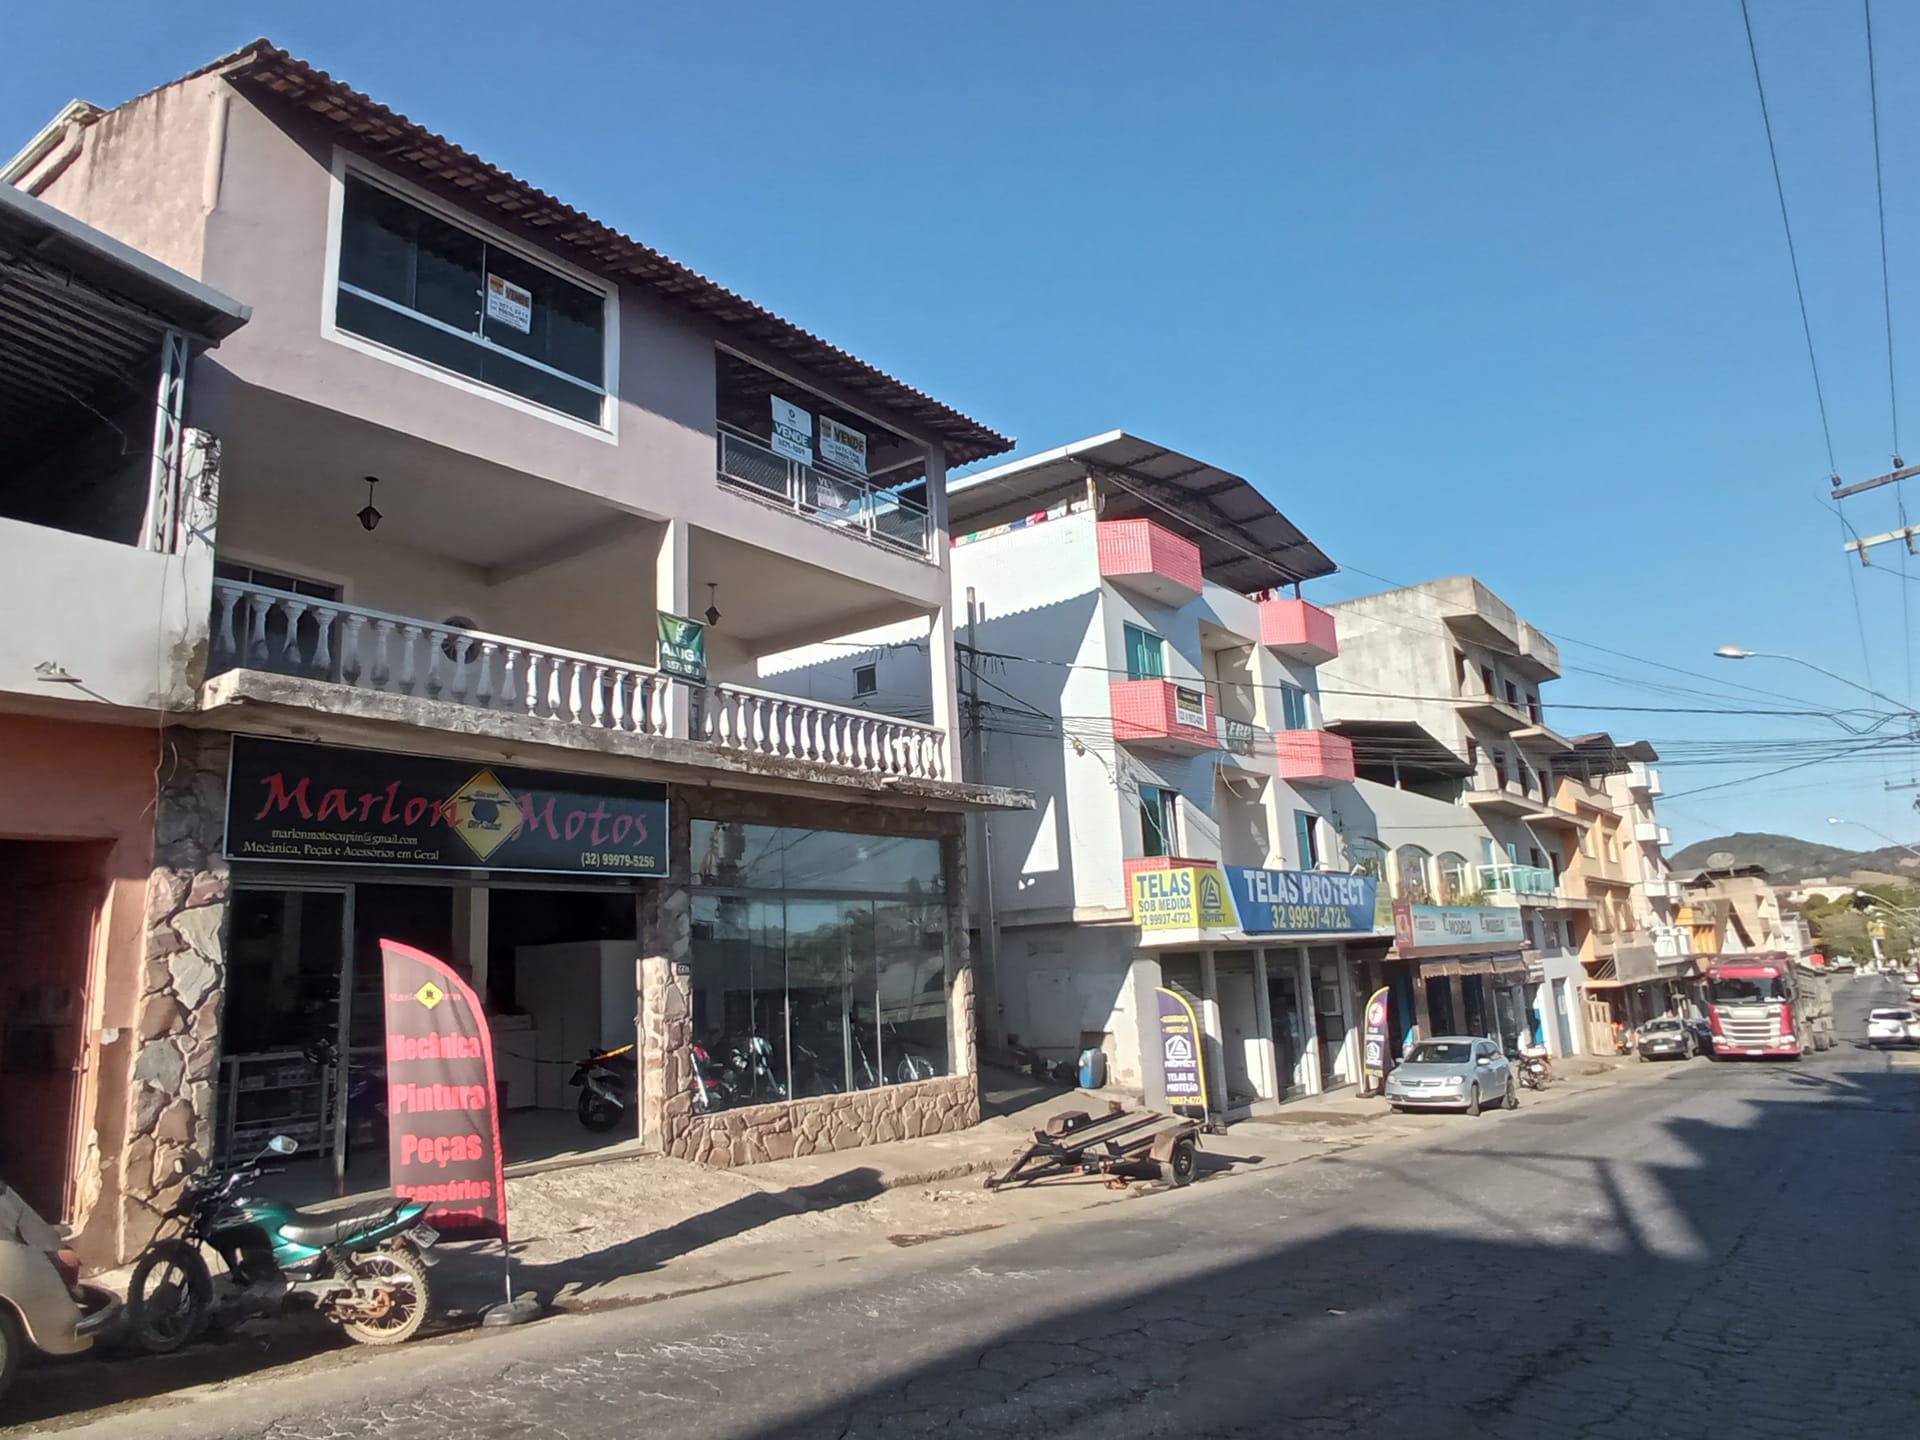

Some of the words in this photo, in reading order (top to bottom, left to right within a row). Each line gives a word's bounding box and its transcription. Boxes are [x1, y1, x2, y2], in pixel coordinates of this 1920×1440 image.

[775, 422, 809, 447] VENDE
[254, 772, 464, 828] Marlon
[511, 791, 649, 847] Motos
[304, 844, 333, 857] Peças
[335, 848, 341, 856] e
[344, 845, 395, 859] Acessórios
[397, 849, 412, 859] em
[414, 849, 440, 861] Geral
[581, 852, 600, 868] (32)
[602, 853, 655, 868] 99979-5256
[1136, 871, 1191, 899] TELAS
[1243, 869, 1299, 905] TELAS
[1301, 875, 1365, 906] PROTECT
[1138, 899, 1156, 913] SOB
[1158, 897, 1192, 911] MEDIDA
[1271, 904, 1287, 928] 32
[389, 1031, 481, 1062] Mecânica
[391, 1082, 486, 1115] Pintura
[400, 1132, 483, 1168] Peças
